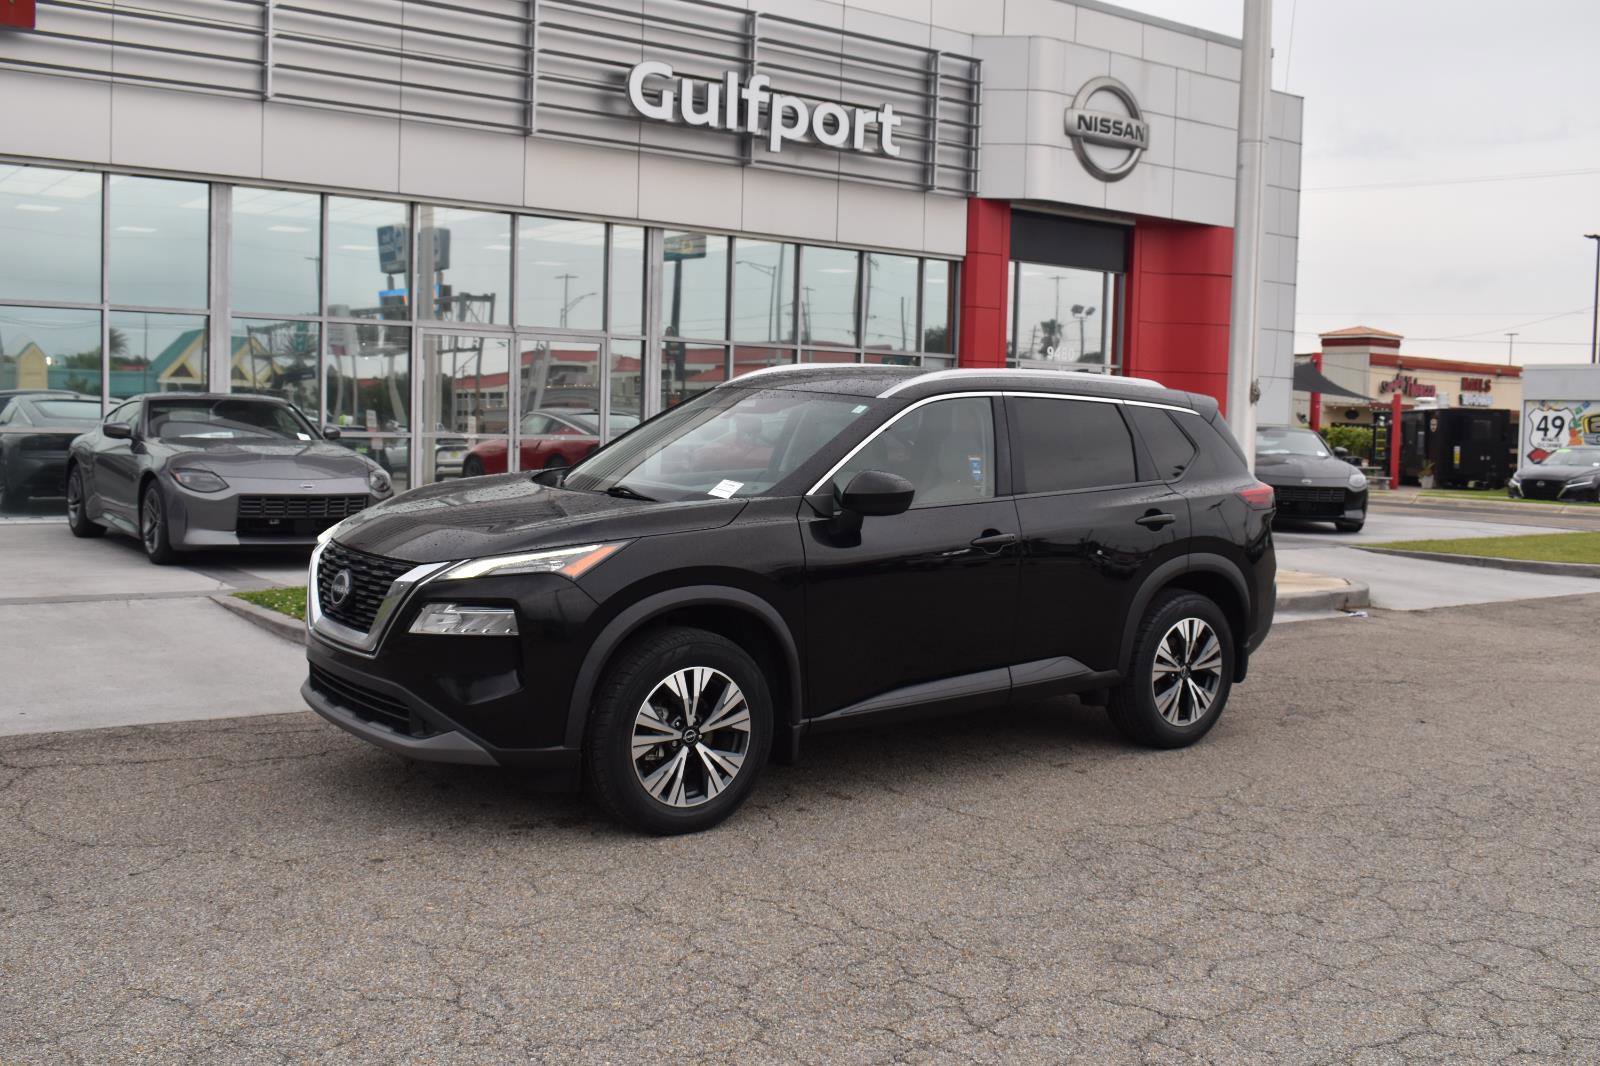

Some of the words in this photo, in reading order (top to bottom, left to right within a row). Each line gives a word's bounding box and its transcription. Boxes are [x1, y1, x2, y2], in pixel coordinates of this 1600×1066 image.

[627, 60, 902, 156] Gulfport
[1077, 114, 1145, 142] NISSAN
[1047, 346, 1074, 360] 9480
[1536, 415, 1565, 437] 49
